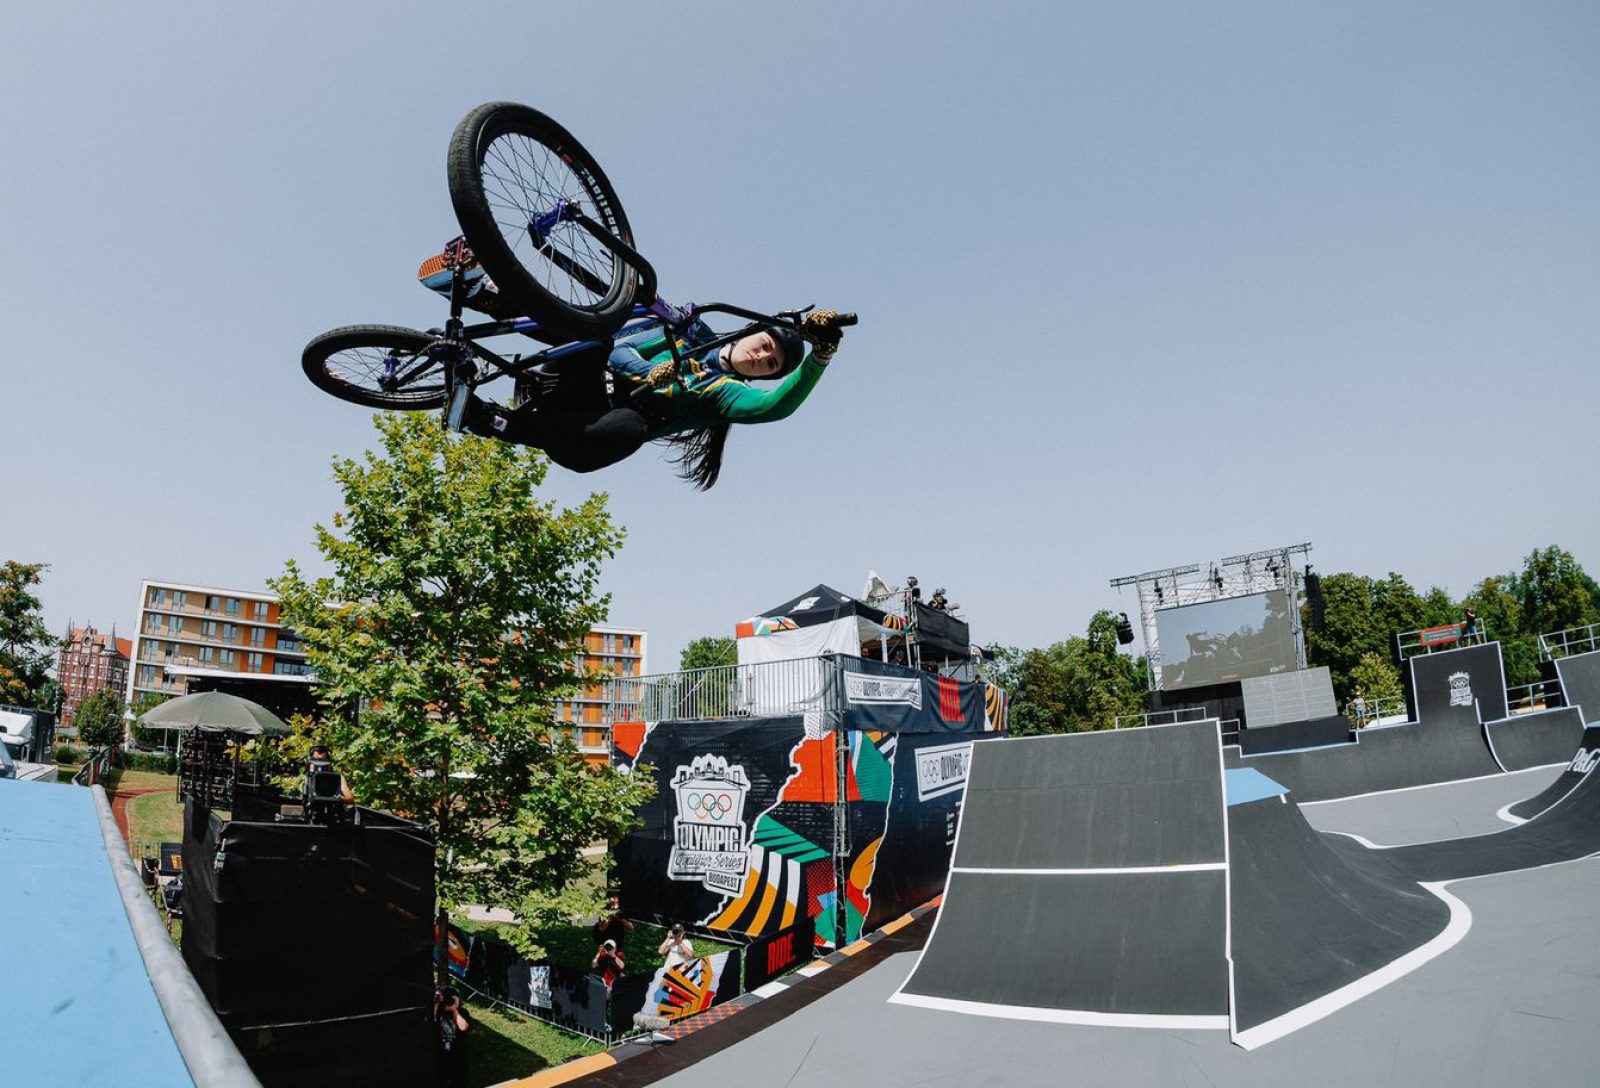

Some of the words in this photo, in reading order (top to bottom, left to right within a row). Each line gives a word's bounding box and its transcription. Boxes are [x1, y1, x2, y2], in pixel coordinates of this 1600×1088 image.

[680, 824, 739, 851] OLYMPIC
[714, 853, 743, 870] Series
[708, 871, 738, 889] BUDAPEST
